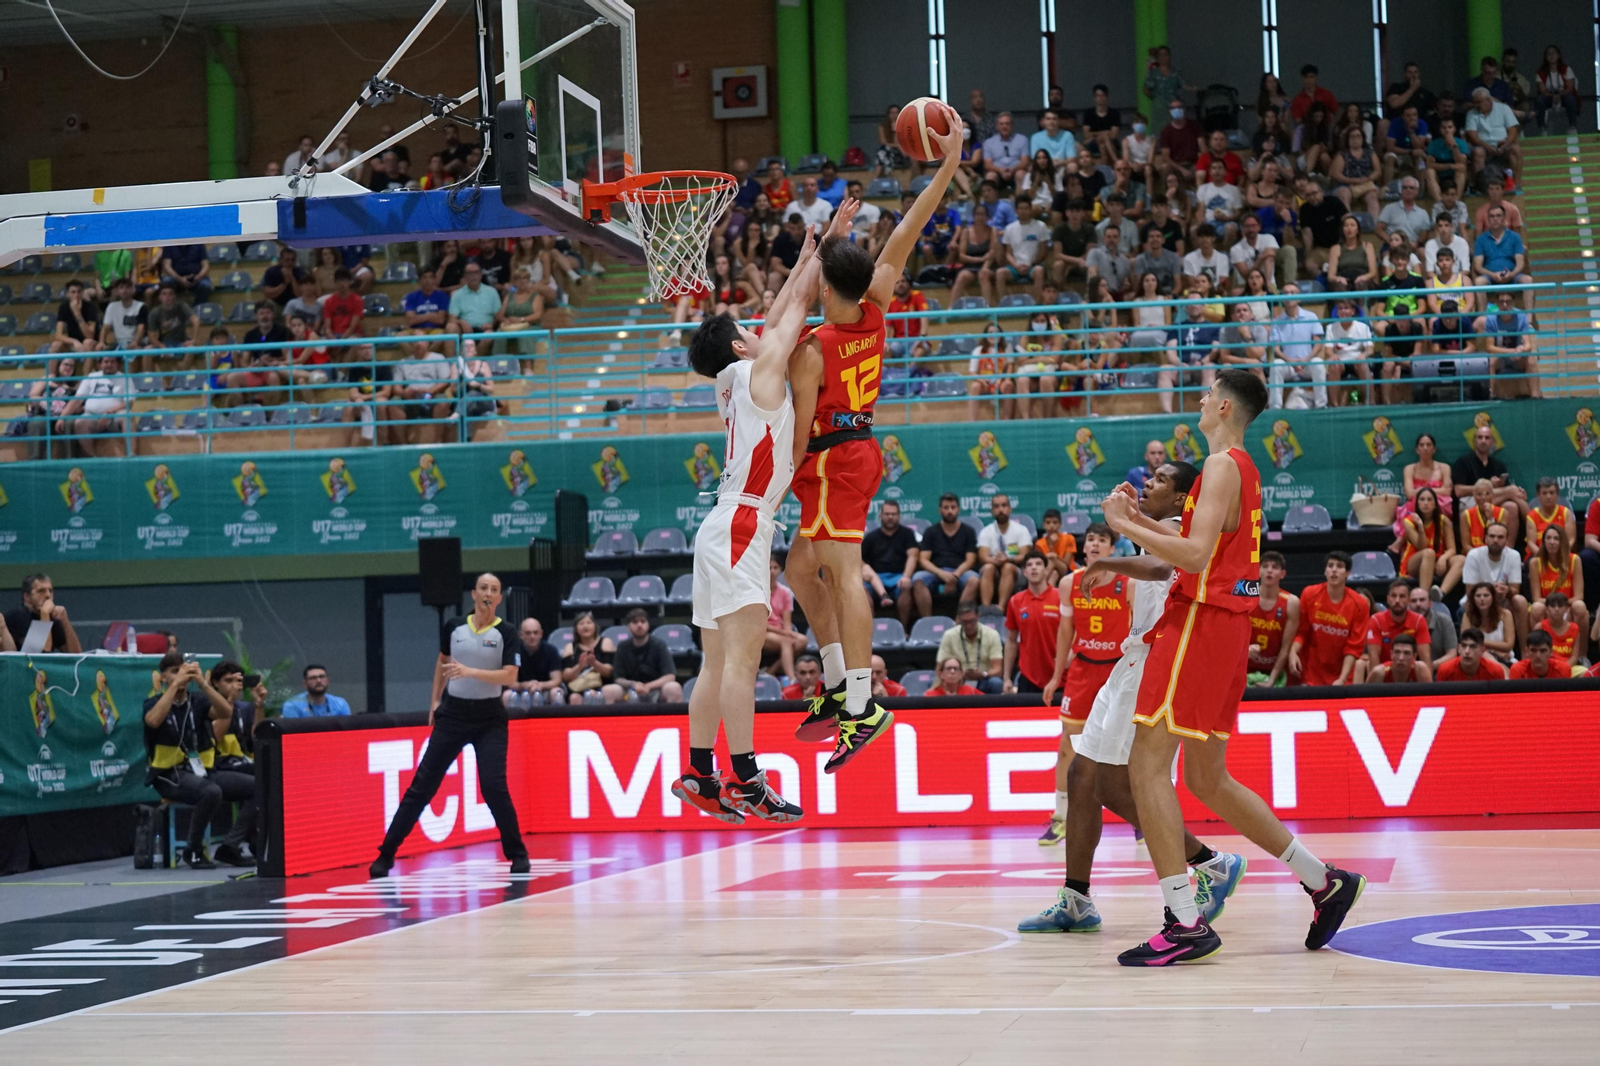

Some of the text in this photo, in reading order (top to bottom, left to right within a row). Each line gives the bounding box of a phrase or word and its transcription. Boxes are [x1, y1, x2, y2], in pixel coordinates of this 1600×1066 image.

[838, 333, 878, 359] LANGARIT
[840, 353, 880, 412] 12
[1557, 476, 1578, 489] U17
[1057, 493, 1078, 507] U17
[1275, 491, 1300, 499] WORLD
[1300, 490, 1315, 498] CUP
[775, 504, 790, 516] 17
[961, 496, 981, 510] U17
[493, 513, 511, 527] U17
[588, 510, 604, 523] U17
[677, 506, 697, 520] U17
[224, 523, 243, 537] U17
[312, 520, 331, 534] U17
[402, 516, 421, 530] U17
[51, 529, 69, 542] U17
[137, 526, 155, 539] U17
[1073, 597, 1122, 610] ESPAÑA
[1089, 615, 1103, 633] 6
[1314, 610, 1348, 626] ESPAÑA
[1256, 634, 1269, 650] 9
[90, 759, 104, 778] U17
[570, 727, 837, 819] Mni
[1238, 707, 1446, 809] TV
[27, 763, 41, 782] U17
